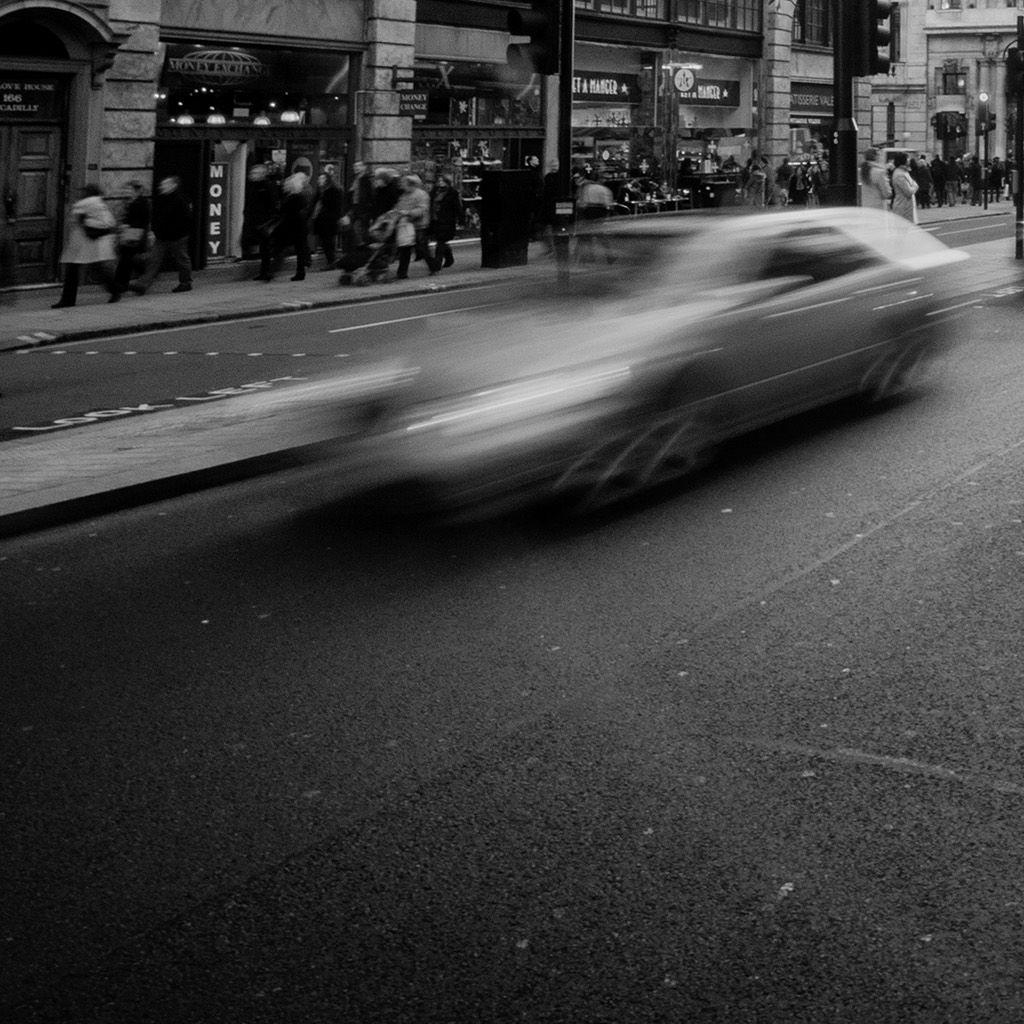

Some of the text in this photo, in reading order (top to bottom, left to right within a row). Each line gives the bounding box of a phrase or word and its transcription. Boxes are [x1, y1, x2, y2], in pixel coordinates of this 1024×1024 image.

[168, 59, 209, 73] MONEY
[24, 83, 55, 91] HOUSE
[590, 78, 618, 95] MANGER
[3, 93, 22, 103] 166
[401, 94, 427, 102] MONEY
[209, 165, 223, 254] MONEY
